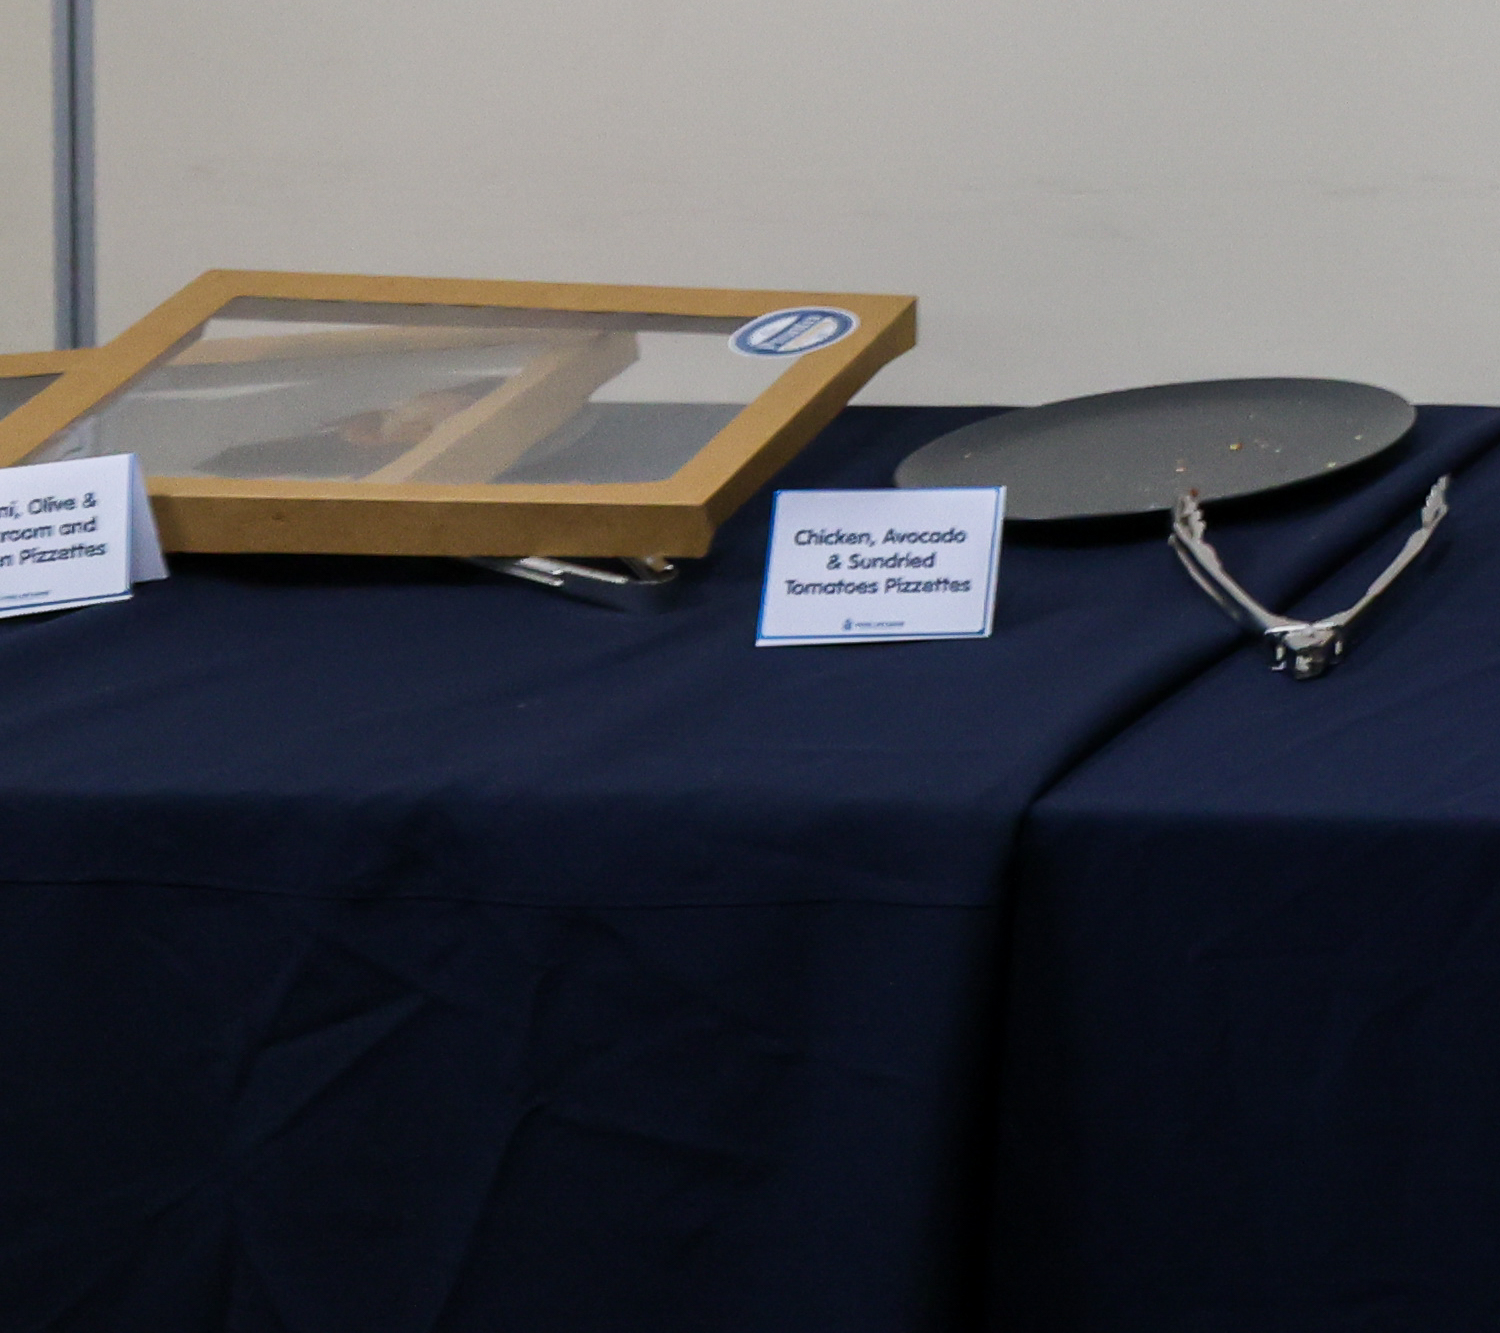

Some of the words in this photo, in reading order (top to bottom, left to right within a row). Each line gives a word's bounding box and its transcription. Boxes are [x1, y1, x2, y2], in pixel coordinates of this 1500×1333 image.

[27, 495, 76, 515] Olive
[82, 492, 97, 508] &
[58, 516, 97, 535] and
[794, 528, 876, 547] Chicken,
[882, 528, 967, 544] Avocado
[19, 542, 107, 565] Pizzettes
[826, 553, 842, 570] &
[847, 551, 937, 569] Sundried
[785, 579, 878, 595] Tomatoes
[884, 577, 971, 594] Pizzettes
